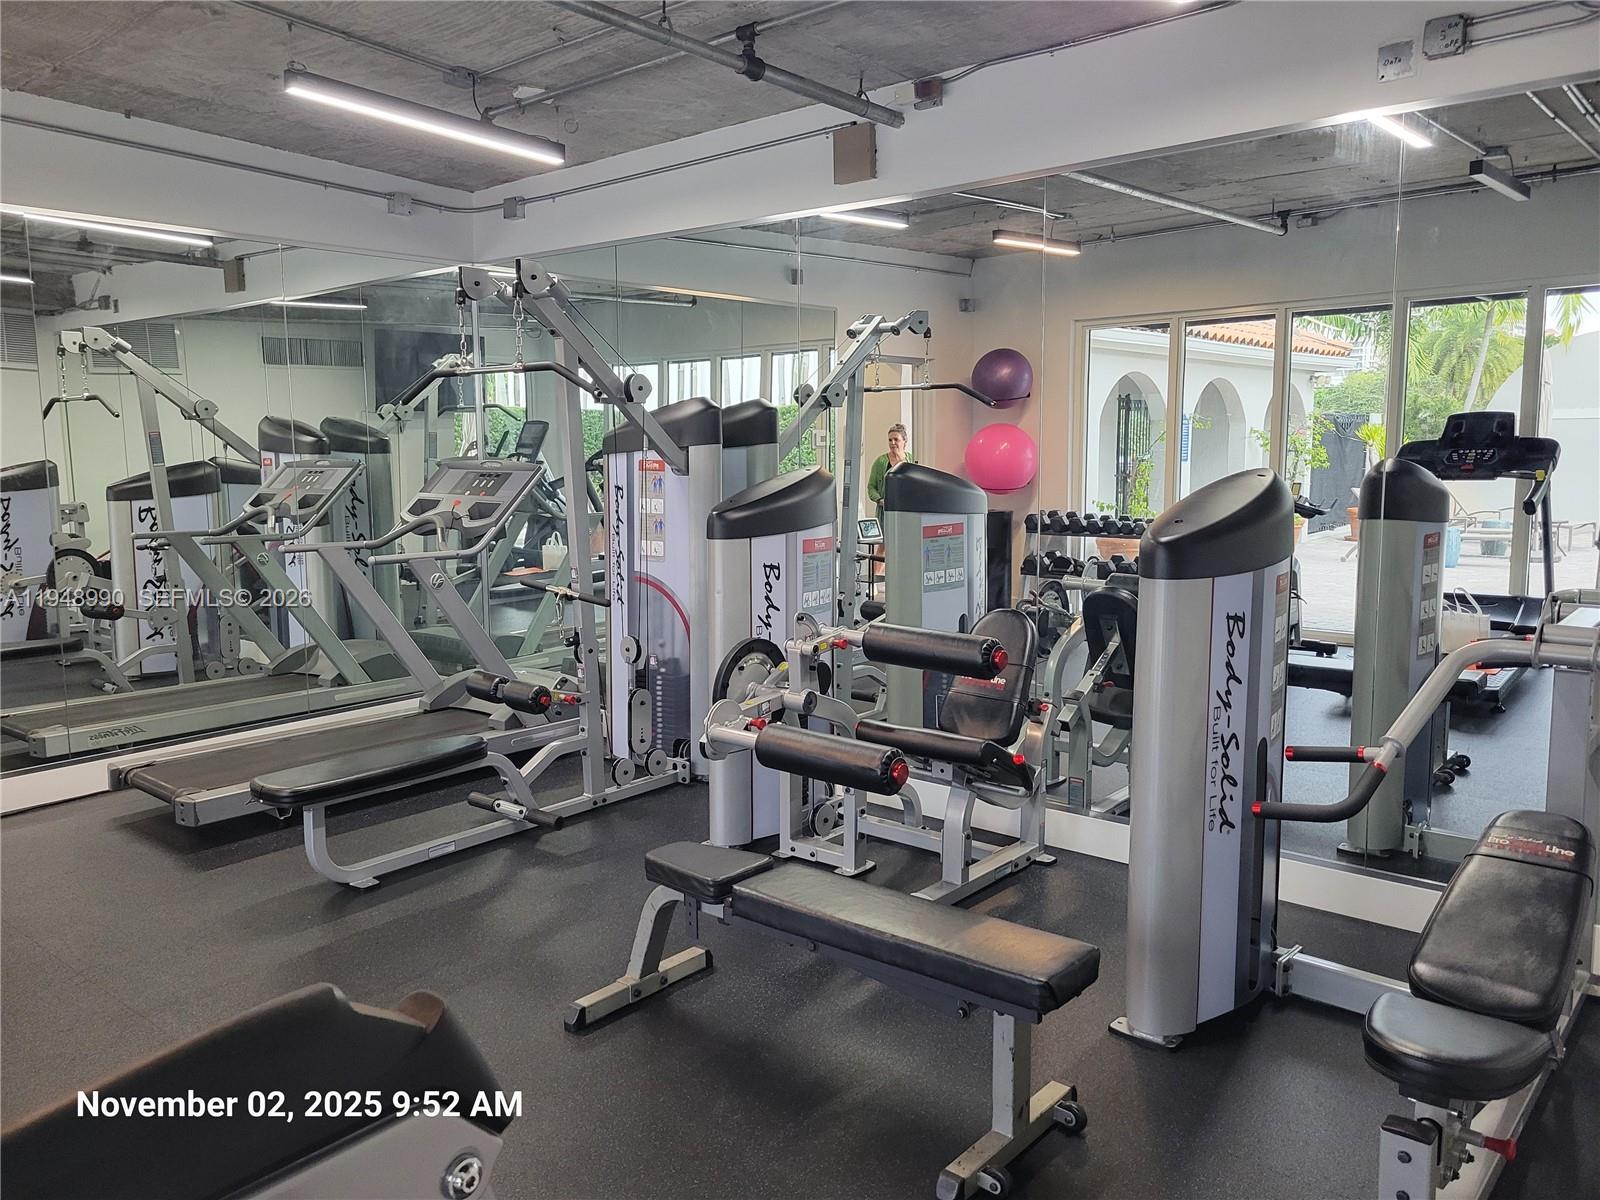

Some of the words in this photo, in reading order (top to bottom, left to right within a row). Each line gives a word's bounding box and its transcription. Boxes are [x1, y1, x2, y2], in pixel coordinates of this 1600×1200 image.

[1211, 705, 1221, 753] Built
[1210, 760, 1218, 786] for
[1208, 794, 1218, 833] Life
[1545, 844, 1576, 858] Line
